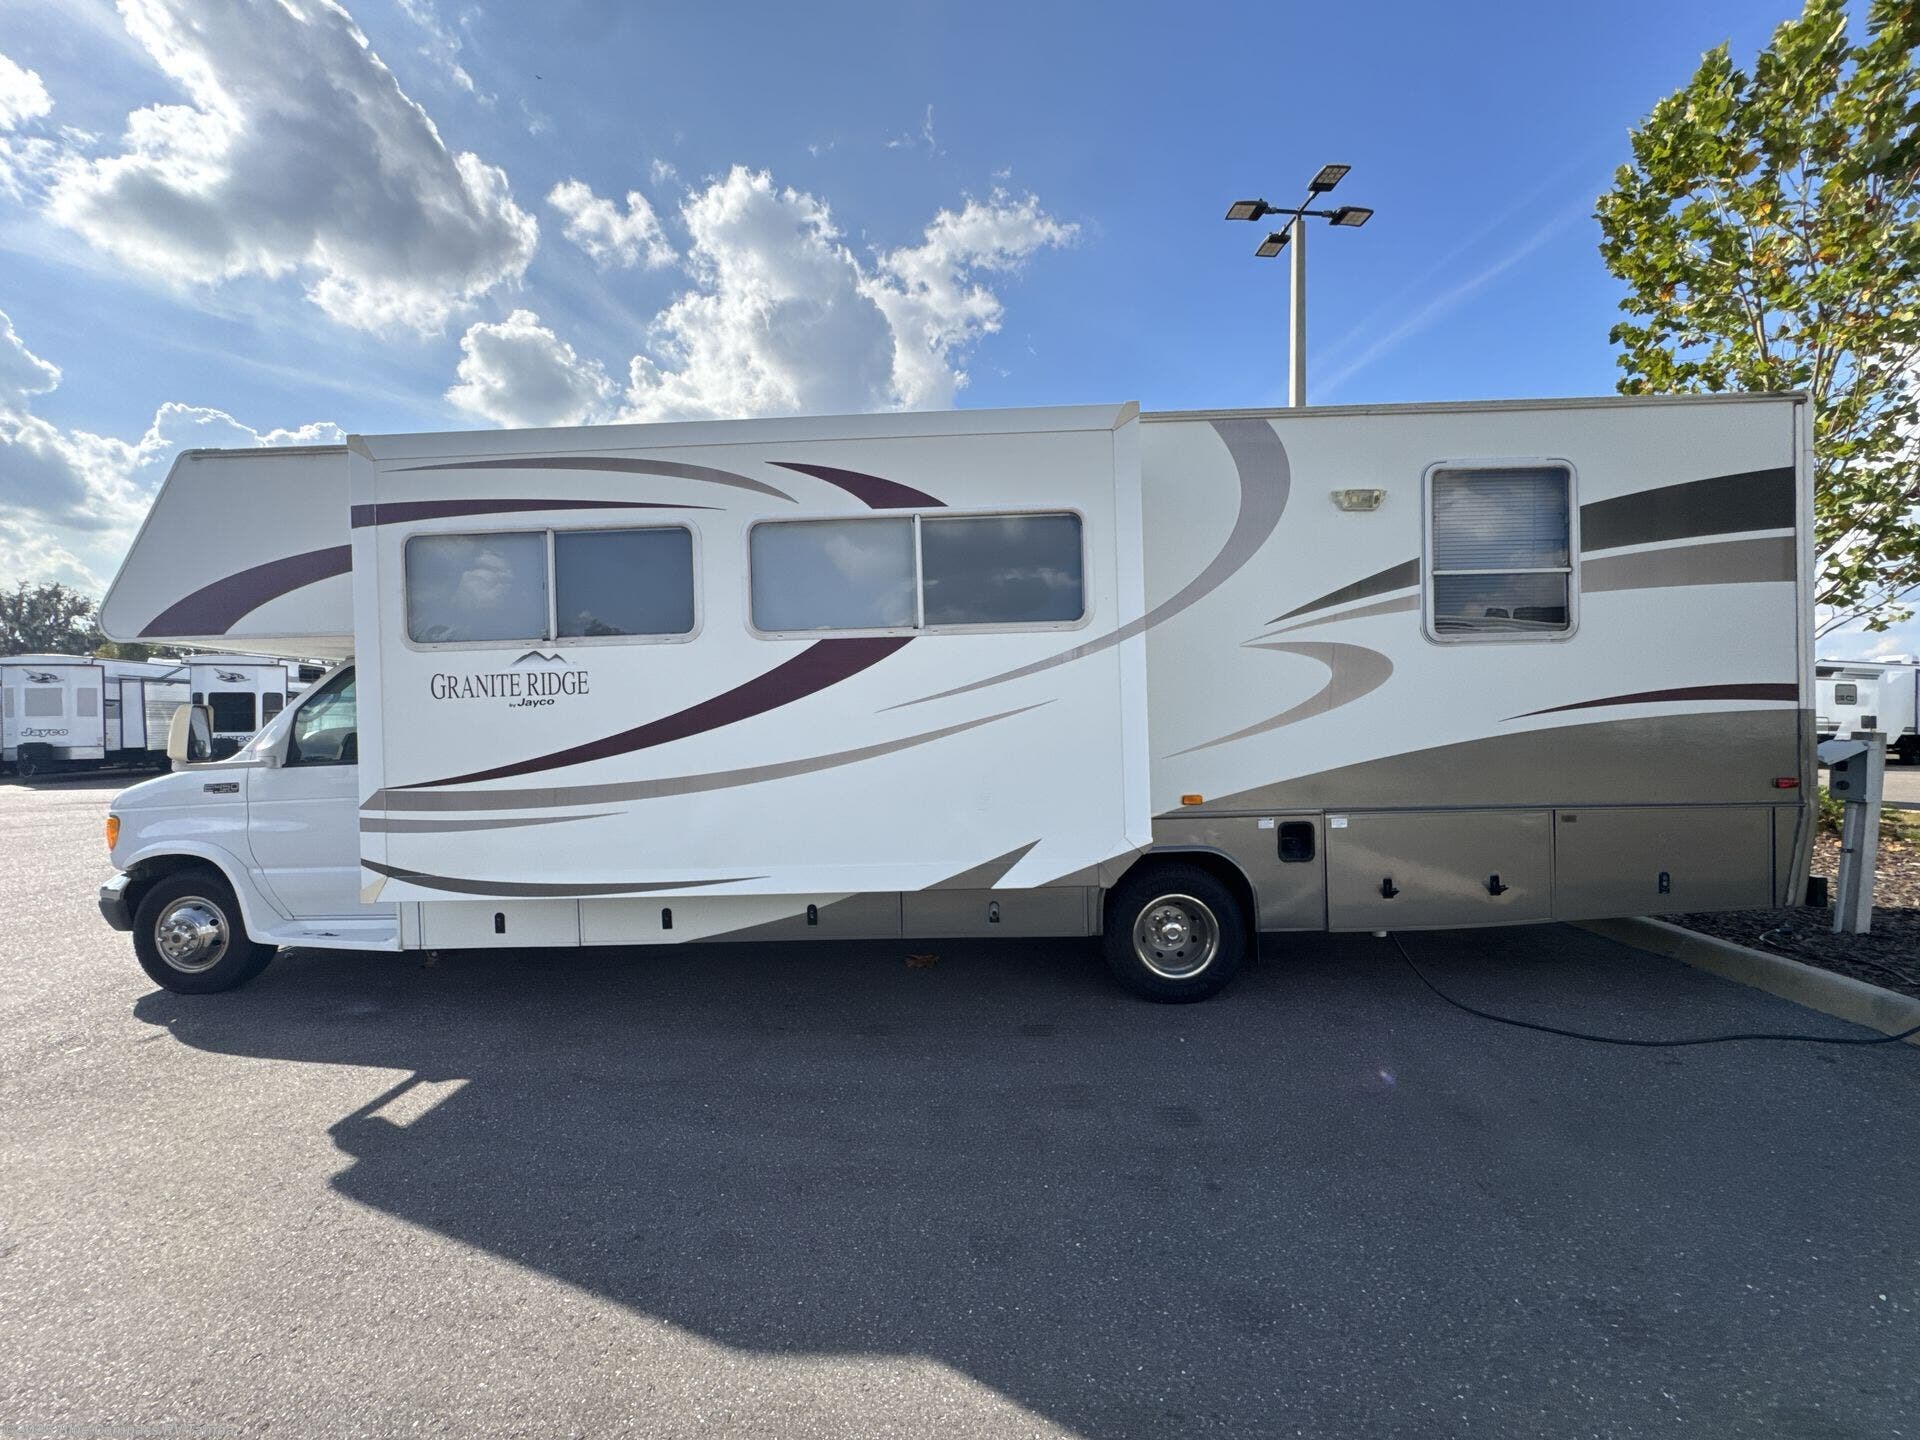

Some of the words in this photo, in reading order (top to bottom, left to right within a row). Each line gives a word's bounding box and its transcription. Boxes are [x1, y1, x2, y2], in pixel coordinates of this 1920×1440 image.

[431, 673, 521, 699] GRANITE
[527, 671, 590, 696] RIDGE
[517, 698, 555, 708] Jayco
[21, 727, 69, 737] Jayco
